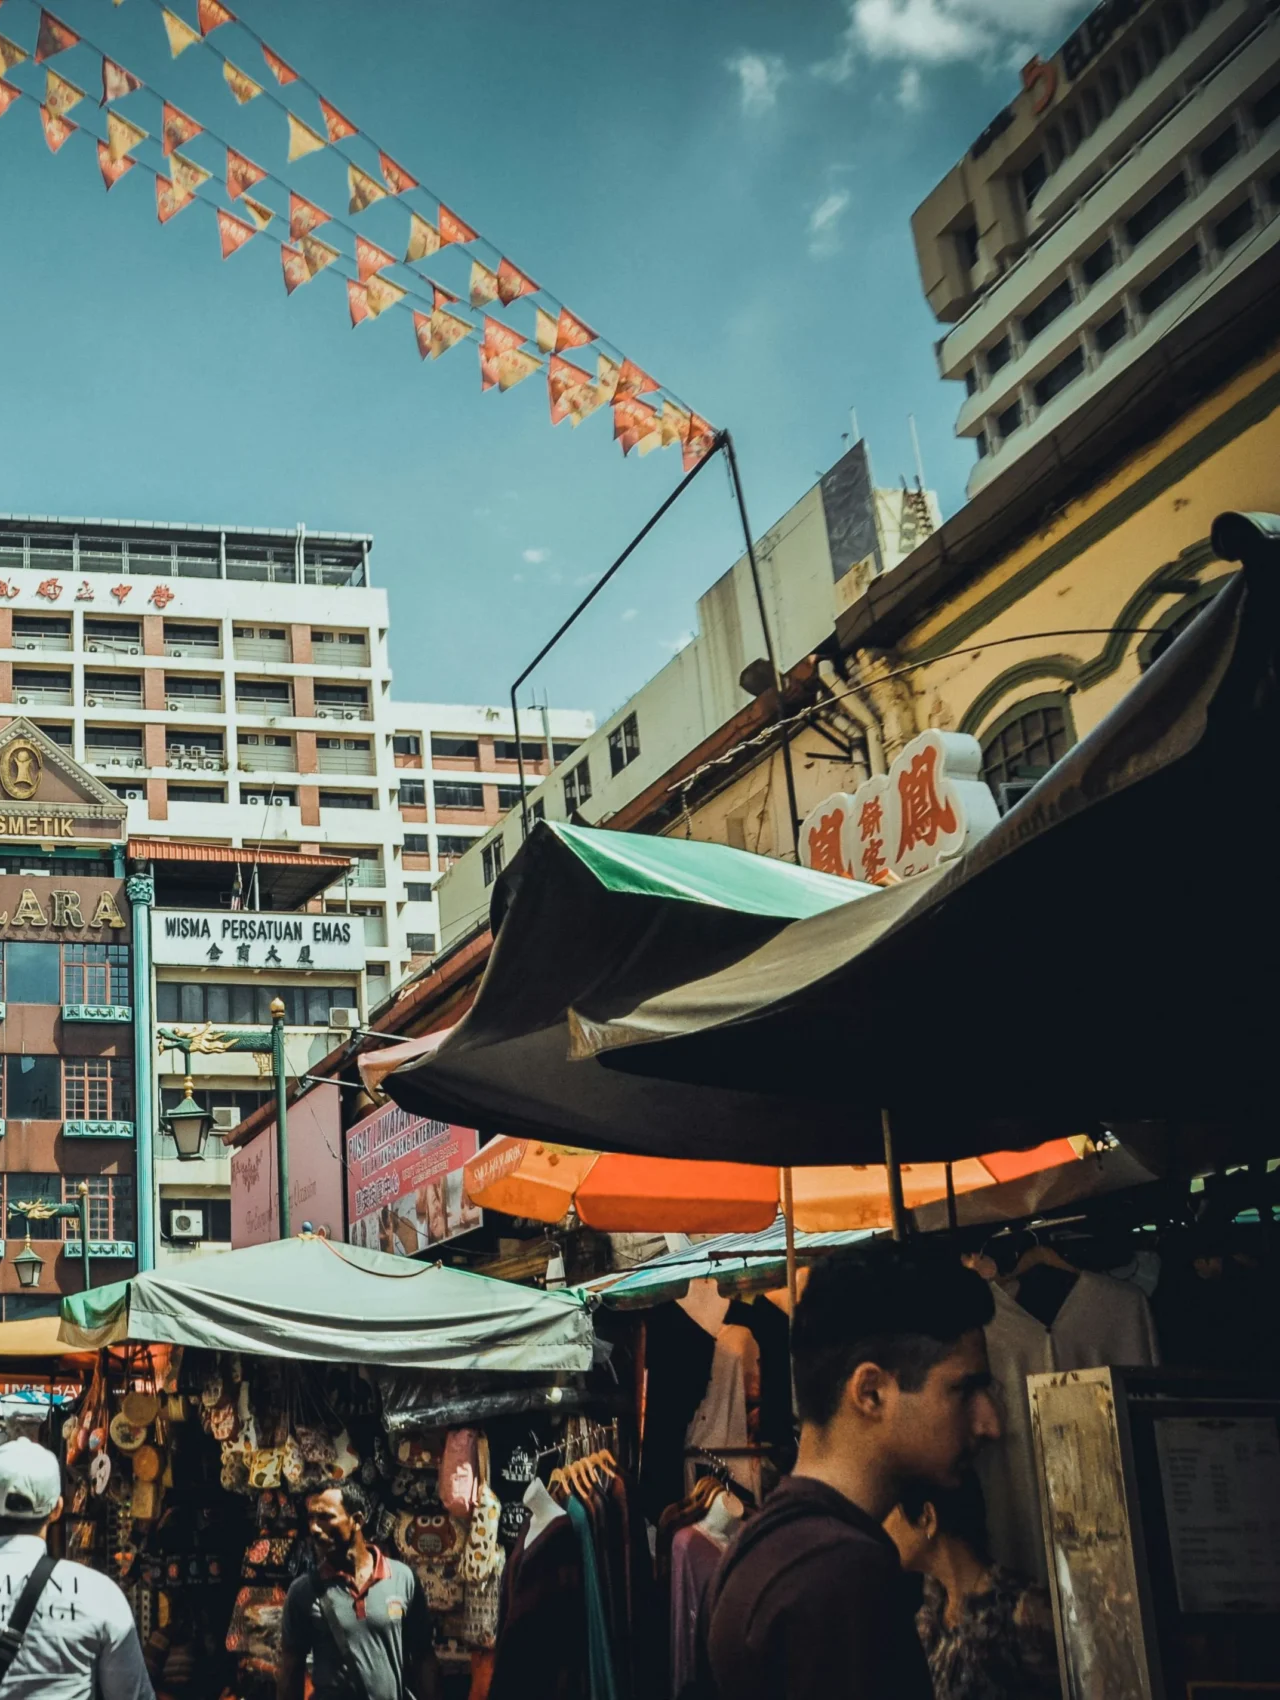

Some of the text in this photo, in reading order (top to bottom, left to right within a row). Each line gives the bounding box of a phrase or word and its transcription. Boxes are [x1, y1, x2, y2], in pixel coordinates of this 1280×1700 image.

[165, 916, 351, 943] WISMA PERSATUAN EMAS
